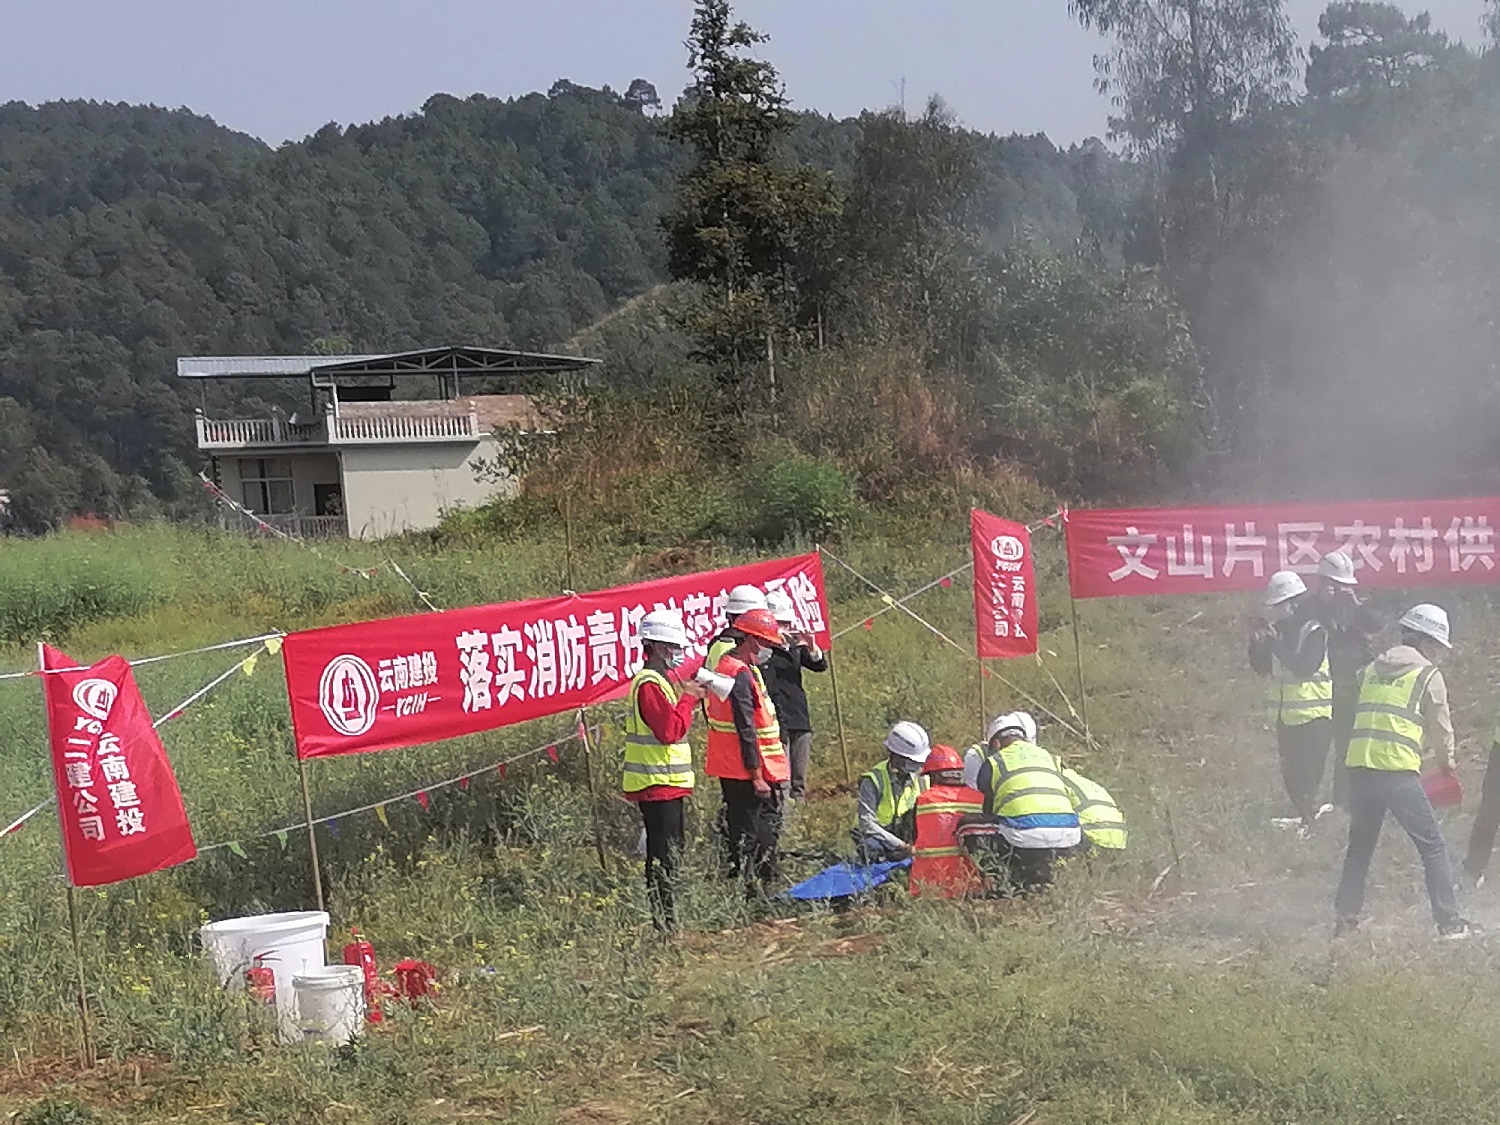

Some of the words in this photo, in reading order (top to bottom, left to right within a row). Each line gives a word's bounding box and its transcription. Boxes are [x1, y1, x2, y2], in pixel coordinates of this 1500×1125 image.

[378, 650, 439, 694] 云南建投
[396, 692, 428, 718] YCIH
[64, 737, 106, 841] 二建公司
[97, 732, 147, 836] 云南建投
